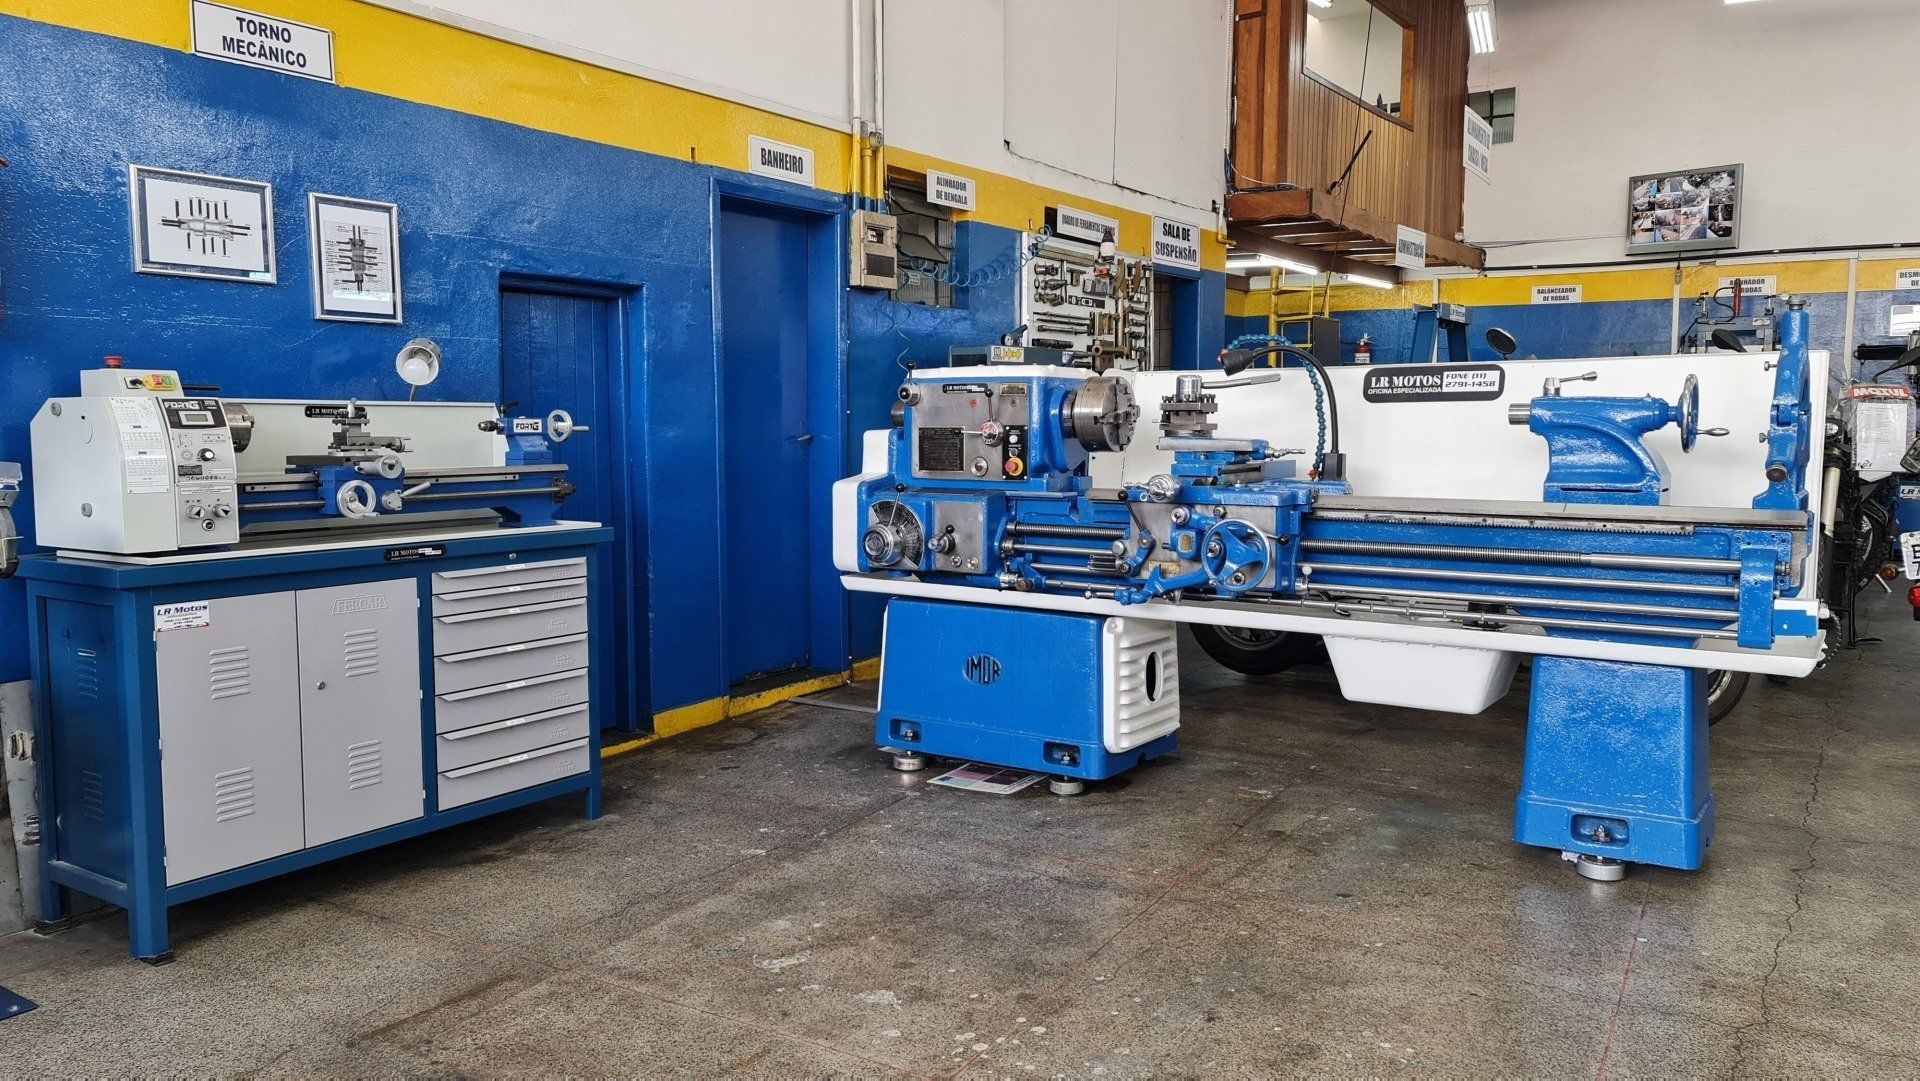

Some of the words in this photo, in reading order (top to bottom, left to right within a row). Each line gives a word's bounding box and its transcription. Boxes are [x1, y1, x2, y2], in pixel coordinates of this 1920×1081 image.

[236, 16, 291, 43] TORNO
[222, 35, 307, 68] MECÂNICO
[761, 147, 803, 174] BANHEIRO
[936, 176, 967, 191] ALINHADOR
[936, 190, 943, 200] DE
[944, 191, 968, 205] BENGALA
[1163, 222, 1180, 240] SALA
[1182, 227, 1190, 242] DE
[1155, 240, 1197, 263] SUSPENSÃO
[1900, 271, 1920, 279] DESM
[1537, 287, 1576, 295] BALANCEADOR
[1371, 376, 1390, 388] LR
[1391, 374, 1442, 388] MOTOS
[1445, 380, 1496, 388] 2791-1458
[157, 608, 171, 616] LR
[173, 605, 208, 613] Motos
